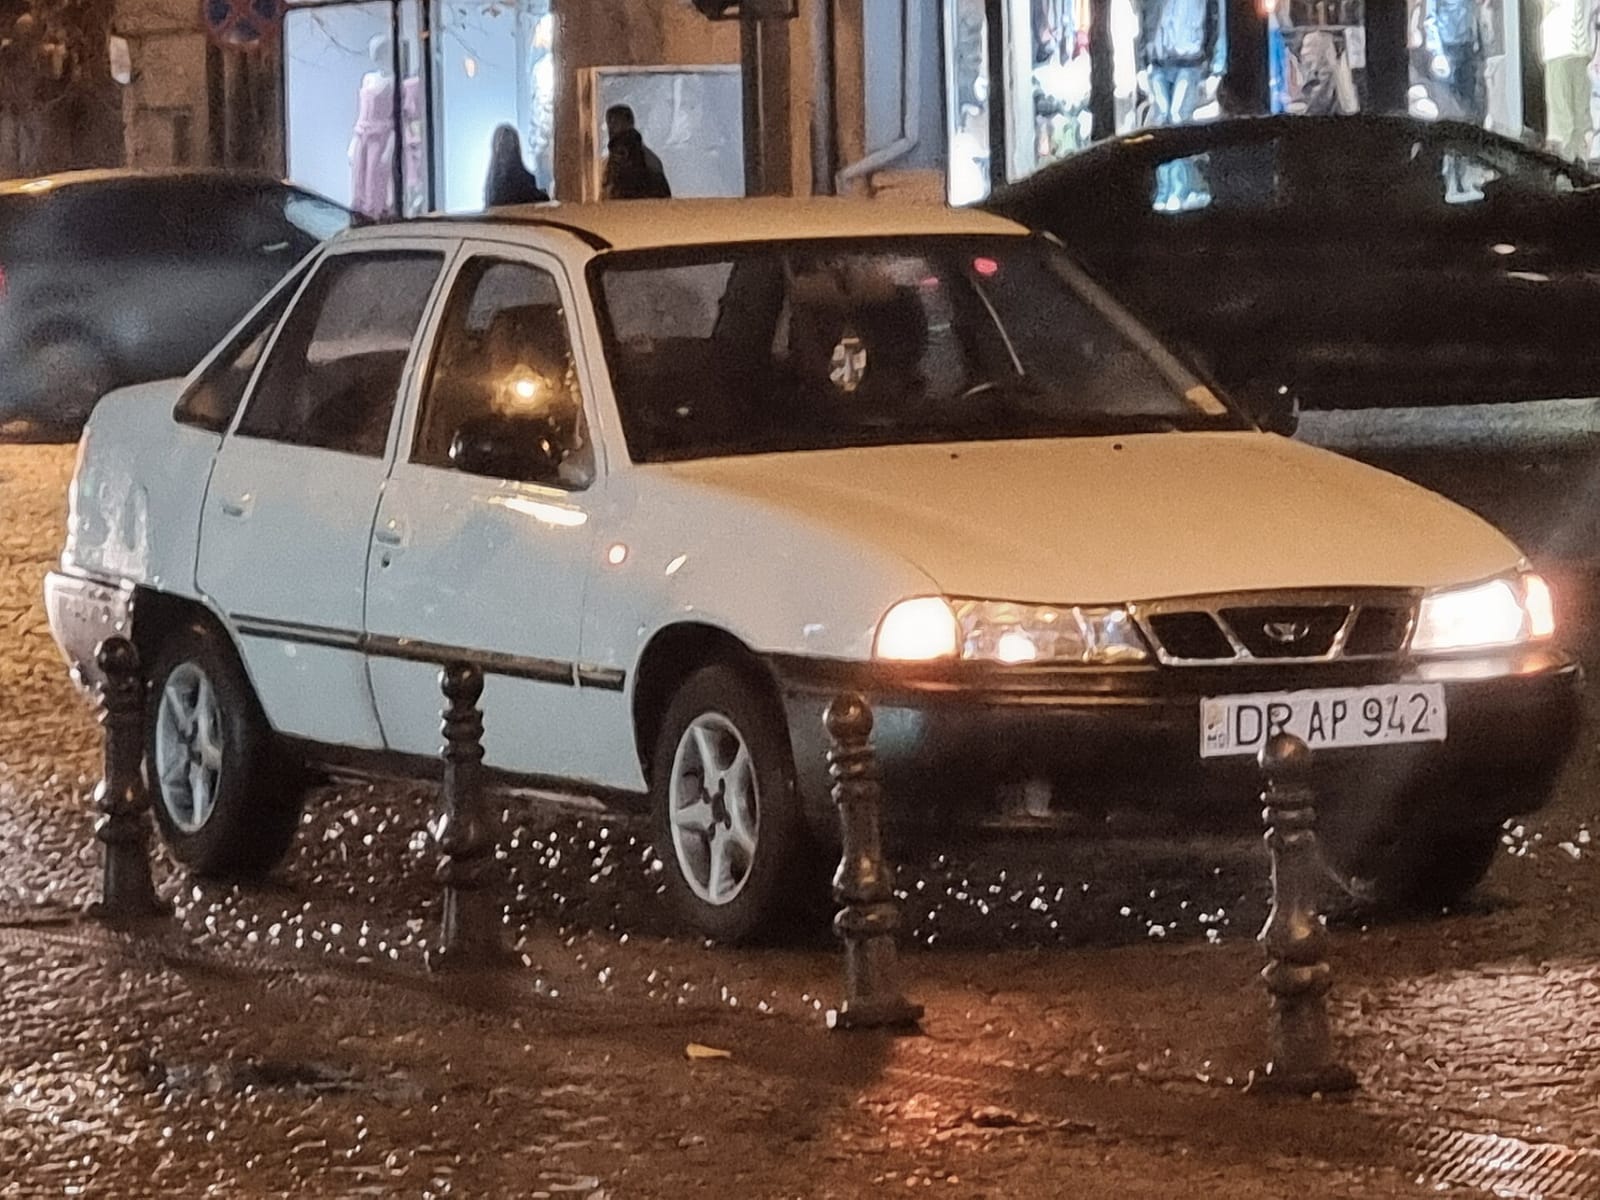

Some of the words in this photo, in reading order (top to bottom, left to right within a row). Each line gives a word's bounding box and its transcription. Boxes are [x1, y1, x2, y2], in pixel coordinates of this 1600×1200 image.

[1236, 703, 1292, 745] DR
[1308, 701, 1347, 741] AP
[1363, 693, 1430, 737] 942
